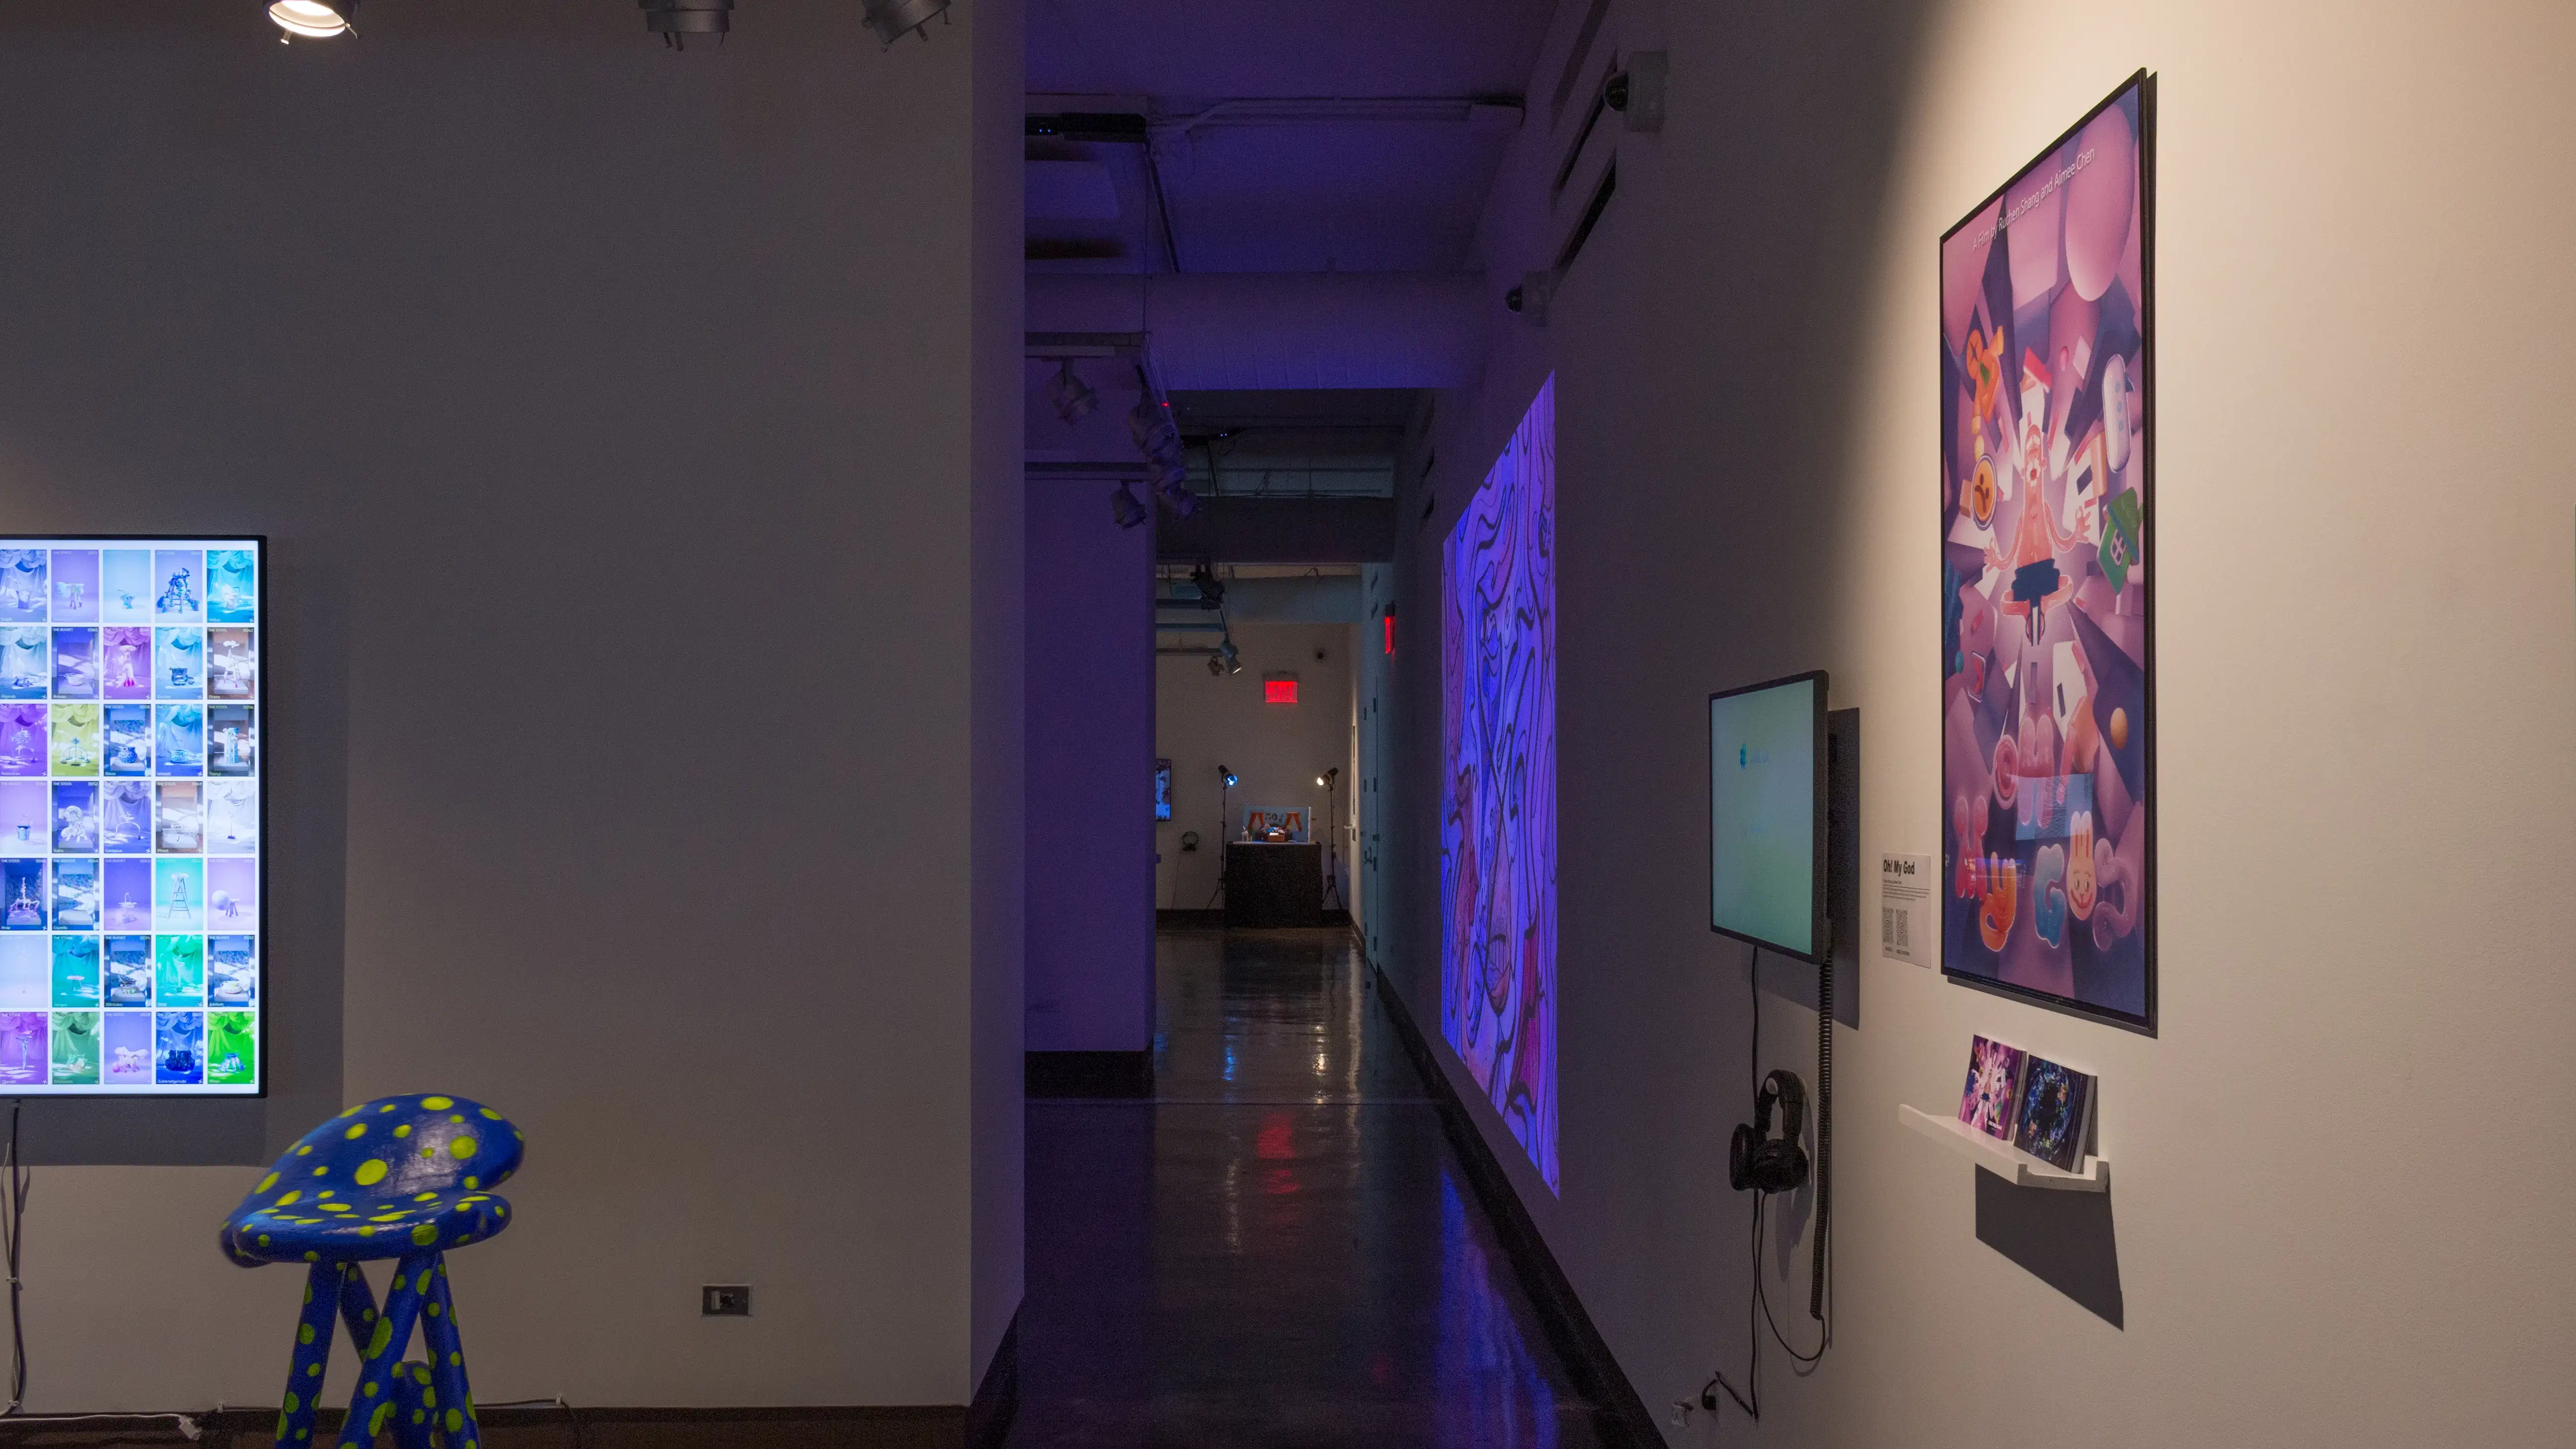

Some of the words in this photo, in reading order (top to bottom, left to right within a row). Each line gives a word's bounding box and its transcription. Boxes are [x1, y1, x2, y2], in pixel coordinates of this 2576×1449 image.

[1973, 238, 1978, 250] A
[1978, 229, 1990, 247] Film
[1991, 223, 1999, 239] by
[1999, 206, 2020, 232] Ruchen
[2021, 192, 2040, 215] Shang
[2041, 176, 2053, 199] and
[2055, 163, 2076, 189] Aimee
[2077, 148, 2094, 170] Chen
[1883, 859, 1892, 872] Oh!
[1894, 860, 1902, 877] My
[1903, 861, 1915, 875] God
